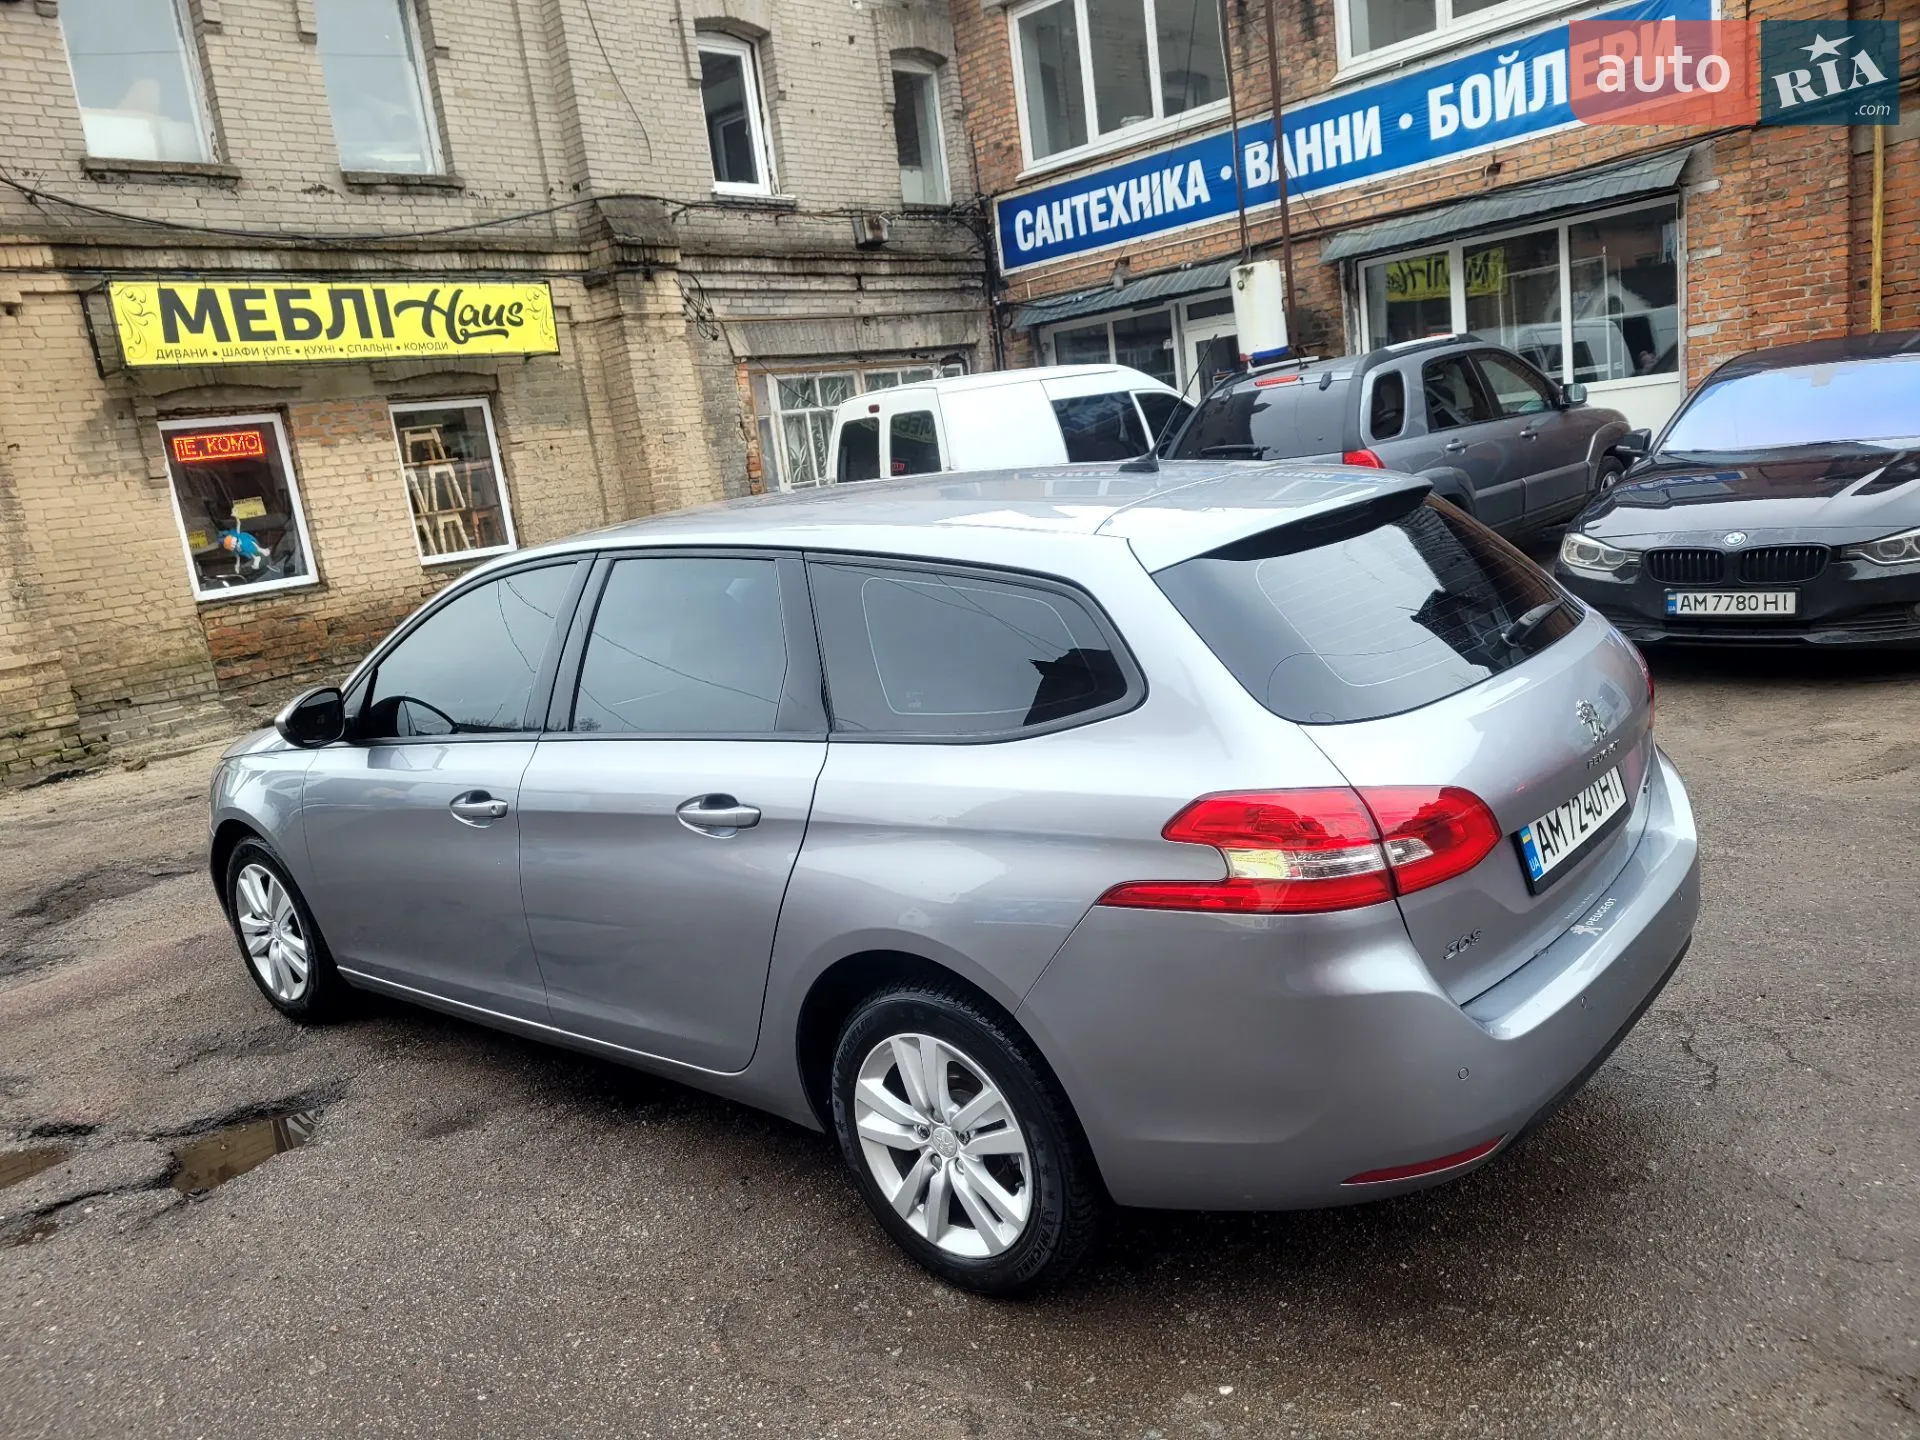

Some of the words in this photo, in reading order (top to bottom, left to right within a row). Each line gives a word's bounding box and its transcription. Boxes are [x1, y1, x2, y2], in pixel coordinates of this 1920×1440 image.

[1014, 159, 1211, 252] САНТЕХНІКА
[1244, 105, 1382, 189] ВАННИ
[157, 288, 395, 343] МЕБЛІ
[394, 288, 524, 345] Haus
[156, 348, 209, 360] ДИВАНИ
[221, 345, 260, 358] ШАФИ
[262, 345, 293, 357] КУПЕ
[303, 343, 336, 355] КУХНІ
[347, 343, 393, 354] СПАЛЬНІ
[404, 341, 450, 352] КОМОДИ
[1529, 855, 1541, 872] UA
[1585, 897, 1618, 926] PEUGEOT
[1443, 928, 1482, 960] 308
